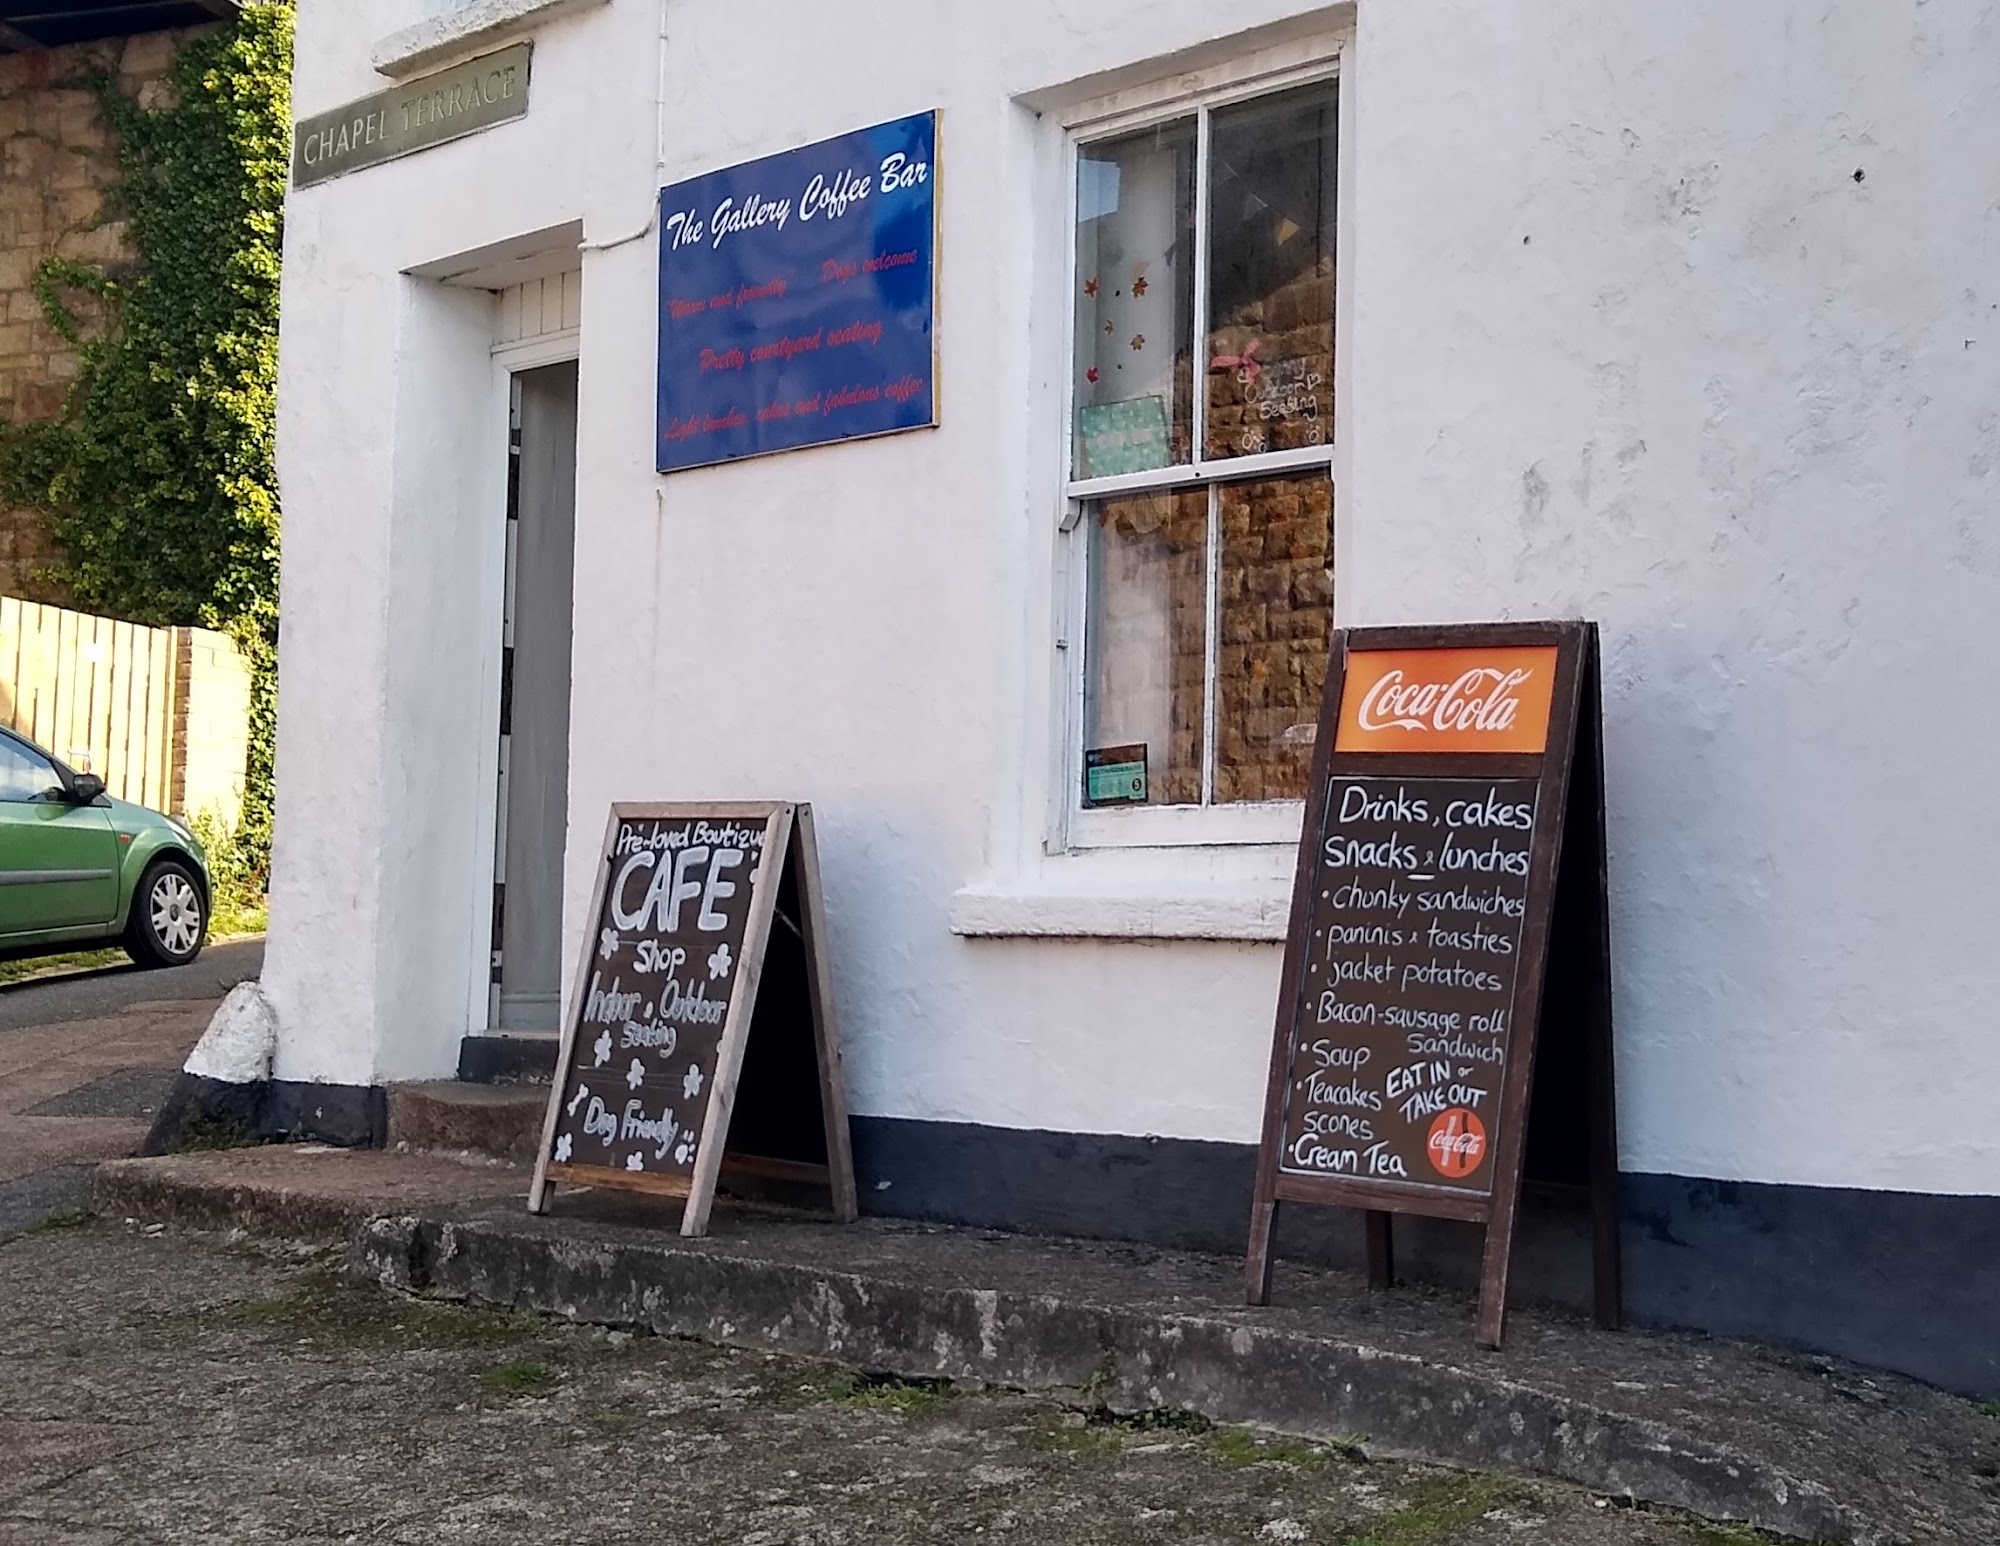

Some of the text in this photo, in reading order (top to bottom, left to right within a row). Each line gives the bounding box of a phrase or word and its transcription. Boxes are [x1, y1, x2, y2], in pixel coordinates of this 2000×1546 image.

[303, 65, 516, 165] CHAPEL TERRACE
[666, 152, 928, 250] The Gallery Coffee Bar
[862, 248, 918, 273] welcome
[1358, 668, 1534, 732] Coca-Cola
[1445, 787, 1533, 830] cakes
[1324, 831, 1418, 870] Snacks
[1438, 831, 1530, 876] lunches
[611, 846, 744, 933] CAFE
[1417, 885, 1525, 918] sandwiches
[633, 938, 686, 981] Shop
[1326, 921, 1403, 961] paninis
[1427, 917, 1513, 954] toasties
[1327, 951, 1503, 992] jacket potatoes
[584, 970, 642, 1024] Indoor
[659, 978, 727, 1025] Outdoor
[1468, 1008, 1506, 1034] roll
[1311, 1038, 1371, 1072] Soup
[1304, 1069, 1382, 1111] Teacakes
[1386, 1060, 1474, 1098] EAT IN or
[1398, 1083, 1488, 1124] TAKE OUT
[583, 1096, 679, 1160] Dog Friendly
[1293, 1132, 1408, 1177] Cream Tea
